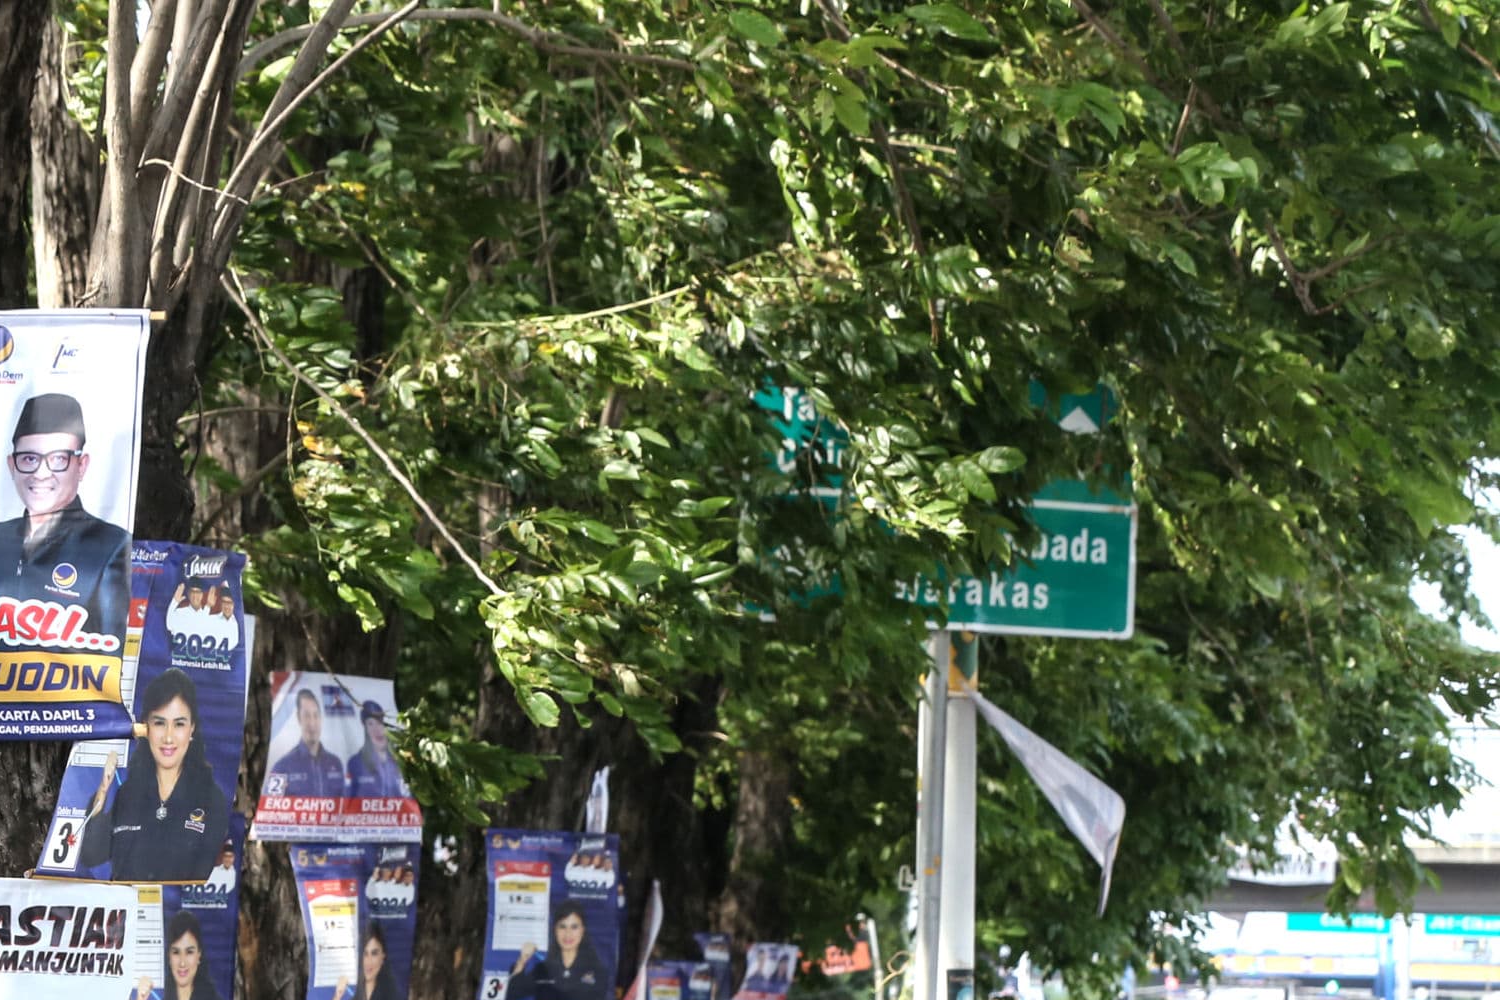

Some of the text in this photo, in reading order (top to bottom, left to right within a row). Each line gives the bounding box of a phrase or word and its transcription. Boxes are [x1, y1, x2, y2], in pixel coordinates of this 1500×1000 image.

[171, 632, 231, 661] 2024
[43, 710, 84, 721] DAPIL
[87, 709, 95, 721] 3
[24, 724, 92, 734] PENJARINGAN
[270, 779, 281, 794] 2
[264, 798, 335, 812] EKO CAHYO
[361, 799, 404, 812] DELSY
[53, 822, 73, 863] 3
[488, 978, 500, 998] 3
